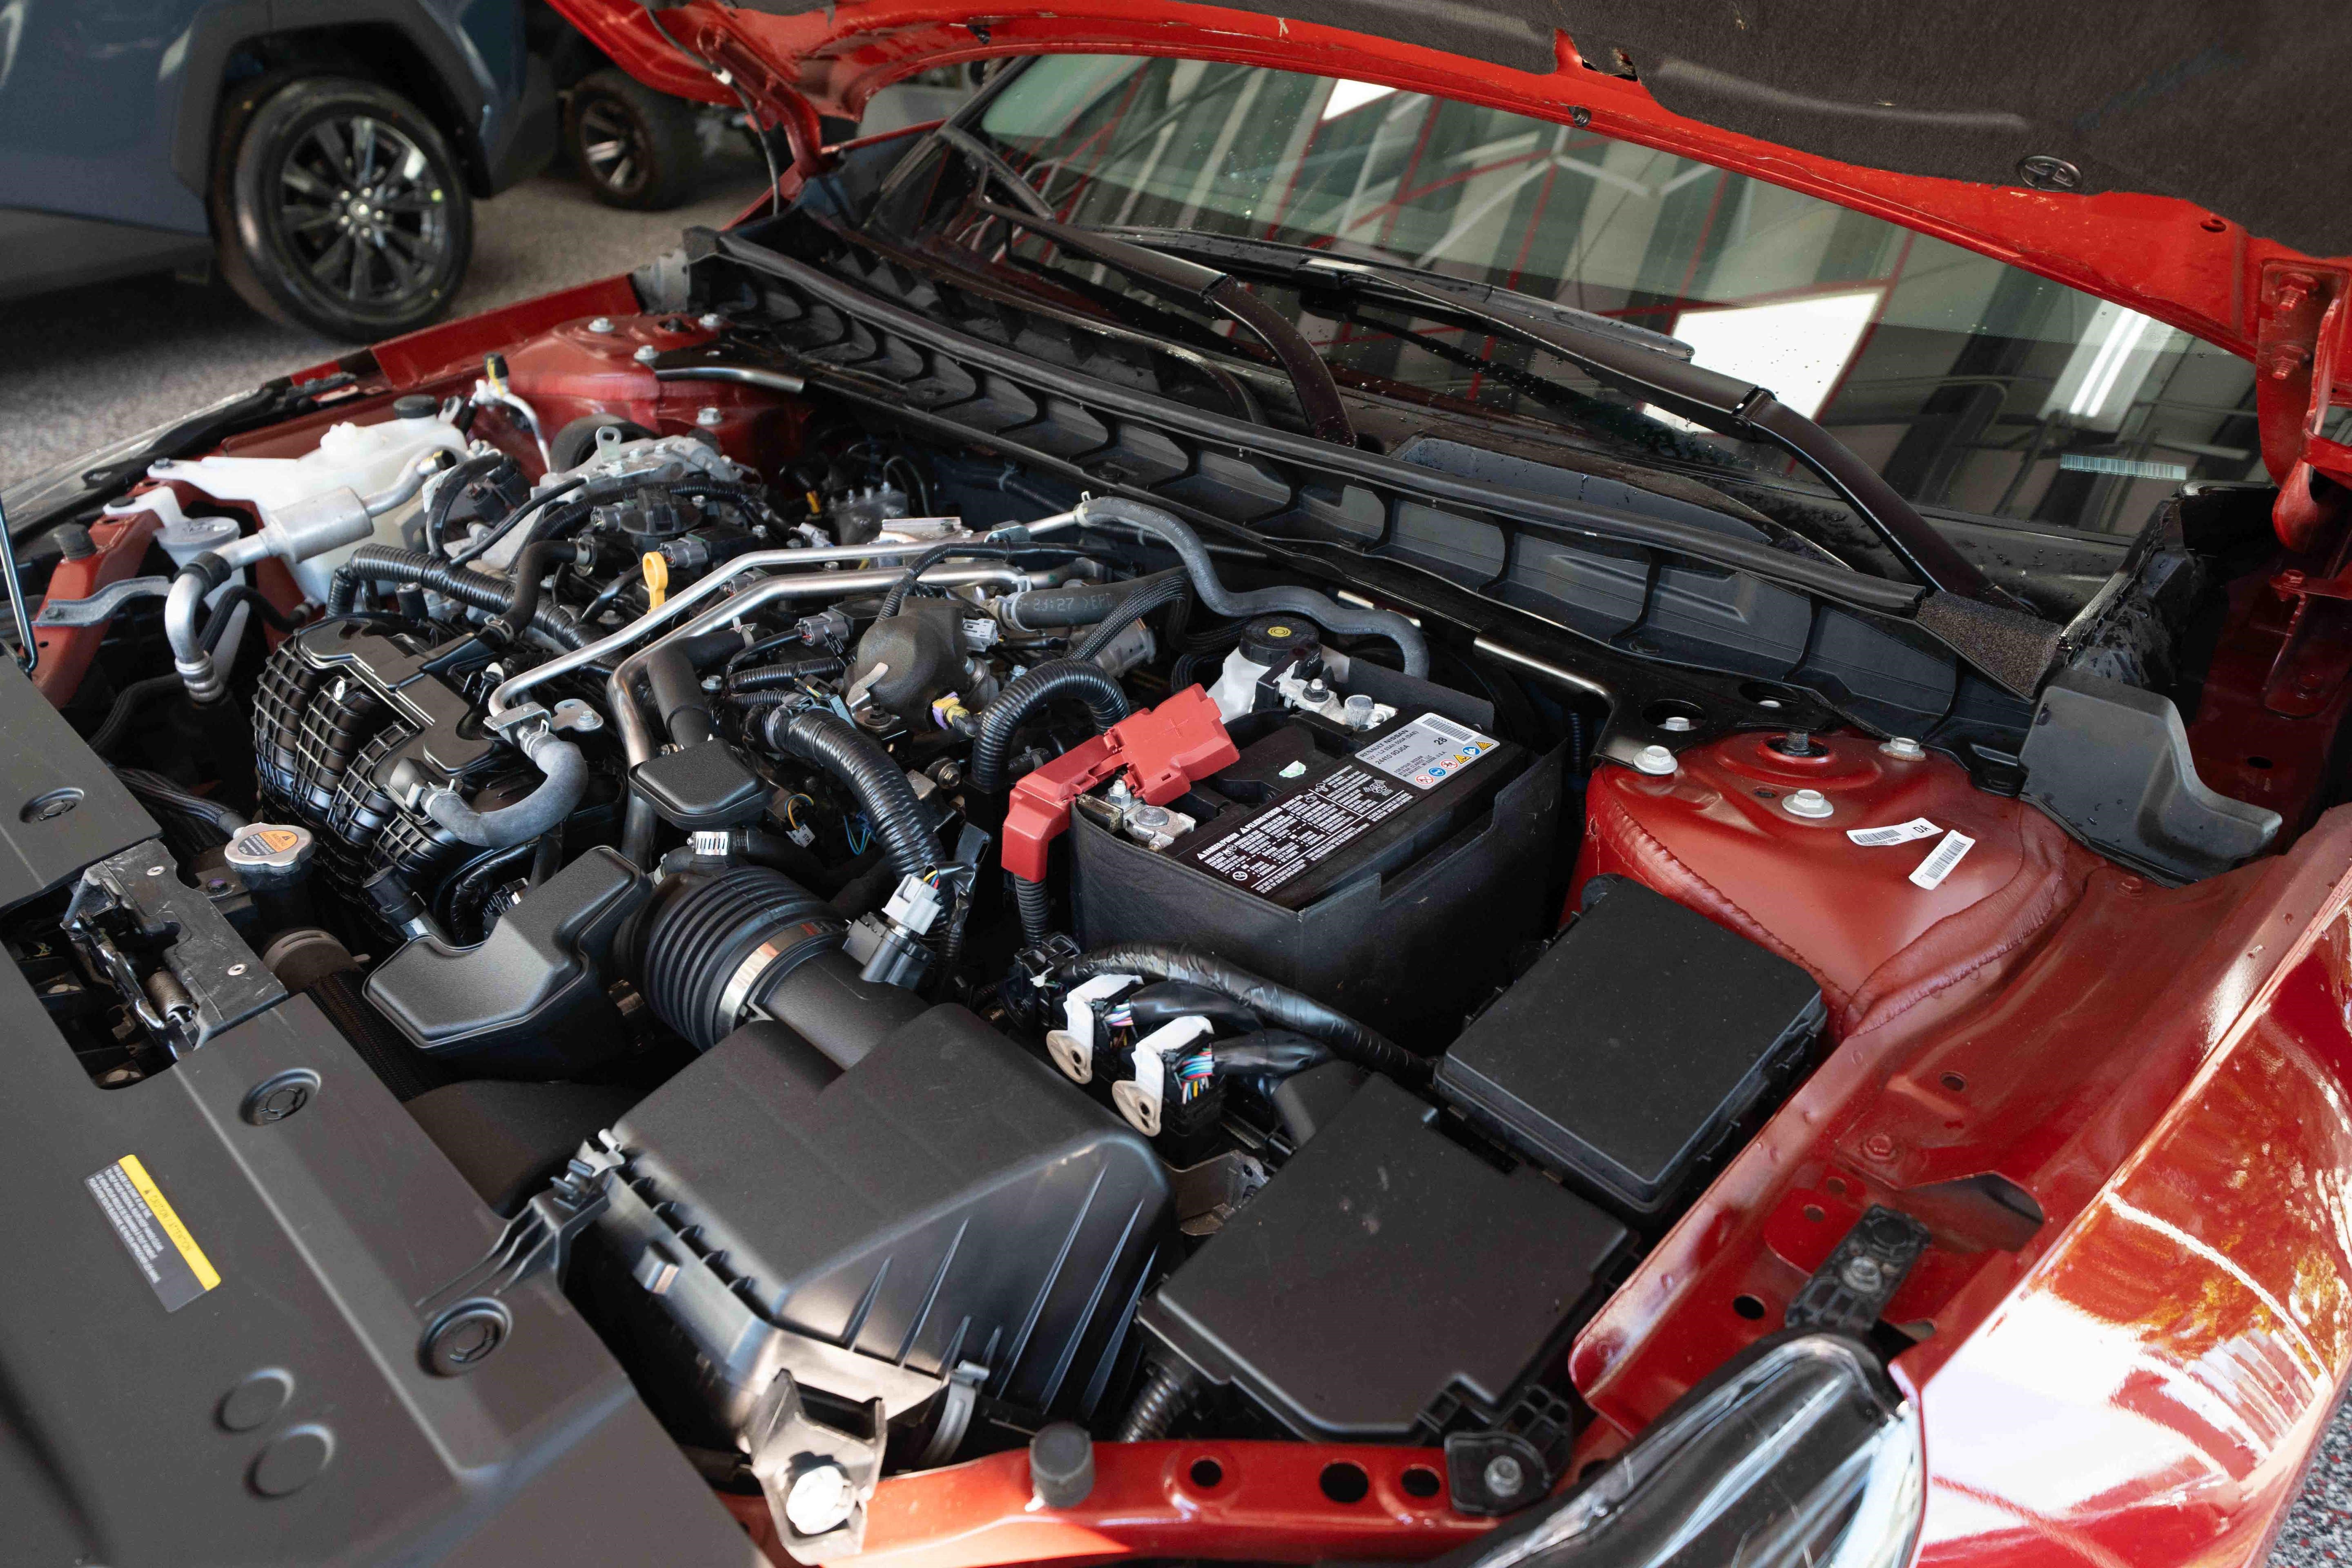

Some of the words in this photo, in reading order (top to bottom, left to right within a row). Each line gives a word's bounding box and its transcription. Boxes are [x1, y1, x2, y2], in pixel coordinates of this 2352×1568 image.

[1404, 730, 1419, 739] (SAE)
[1432, 737, 1448, 745] 28
[1360, 743, 1385, 757] RENAULT
[1383, 729, 1409, 744] NISSAN
[1374, 754, 1393, 764] 24410
[1390, 744, 1410, 755] 9DJ0A
[1410, 755, 1424, 763] NISSAN
[1201, 832, 1241, 855] DANGER/POISON
